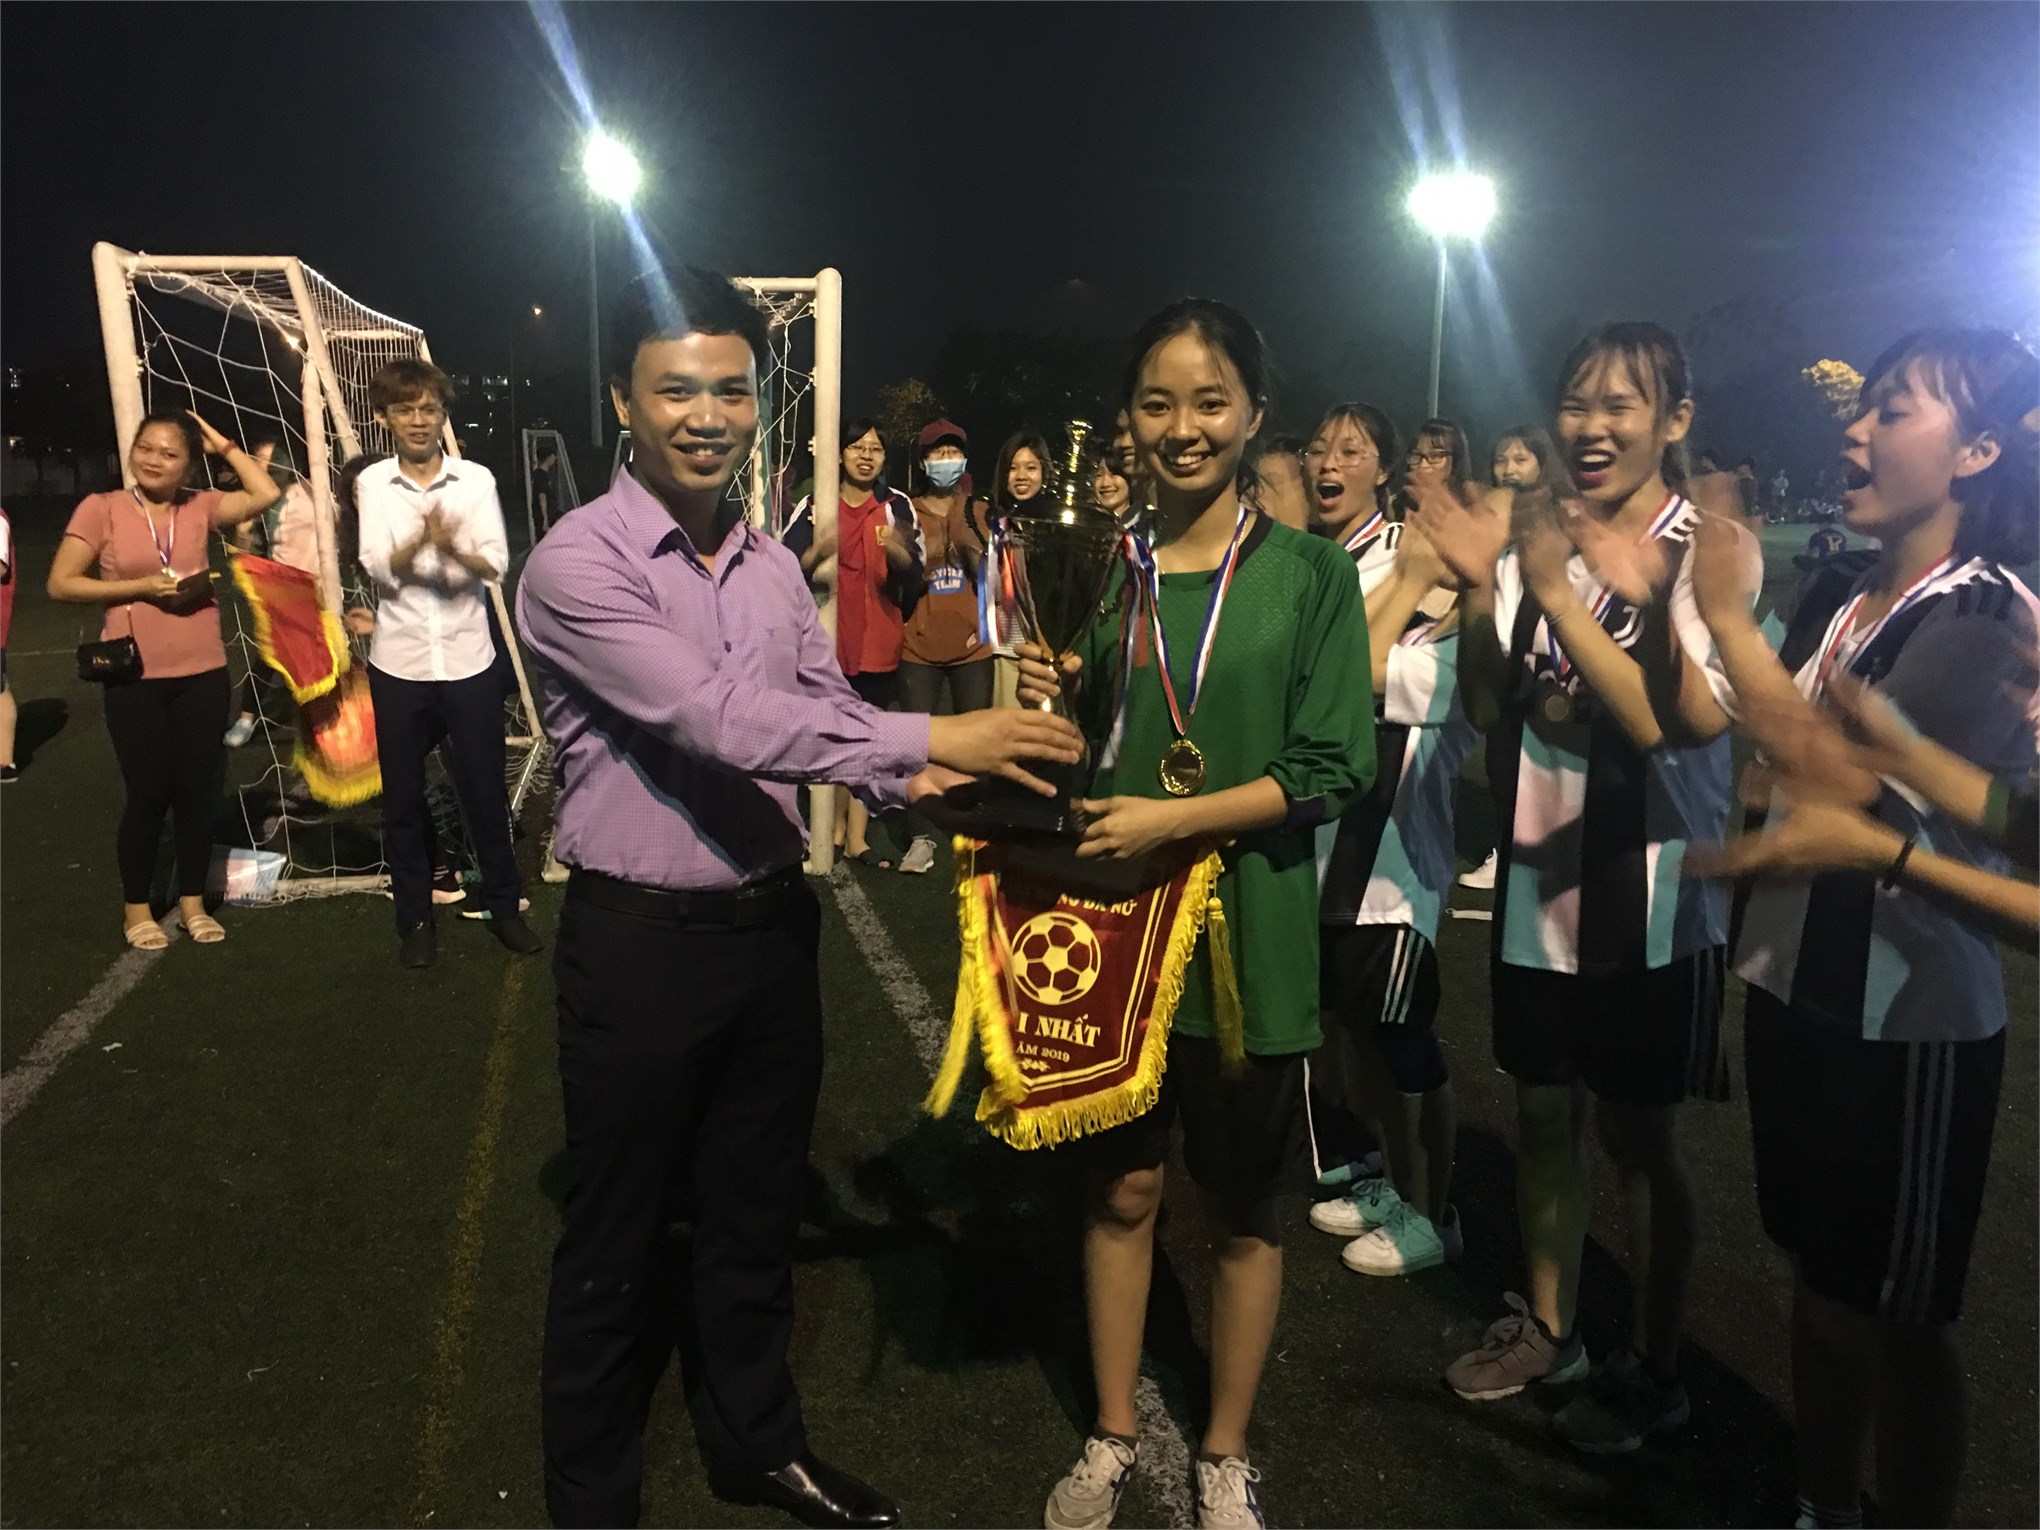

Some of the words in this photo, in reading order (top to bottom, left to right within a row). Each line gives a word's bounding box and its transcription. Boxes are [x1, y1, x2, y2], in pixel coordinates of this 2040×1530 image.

[1034, 1013, 1101, 1048] NHẤT
[1015, 1040, 1039, 1056] ĂM
[1041, 1047, 1070, 1063] 2019
